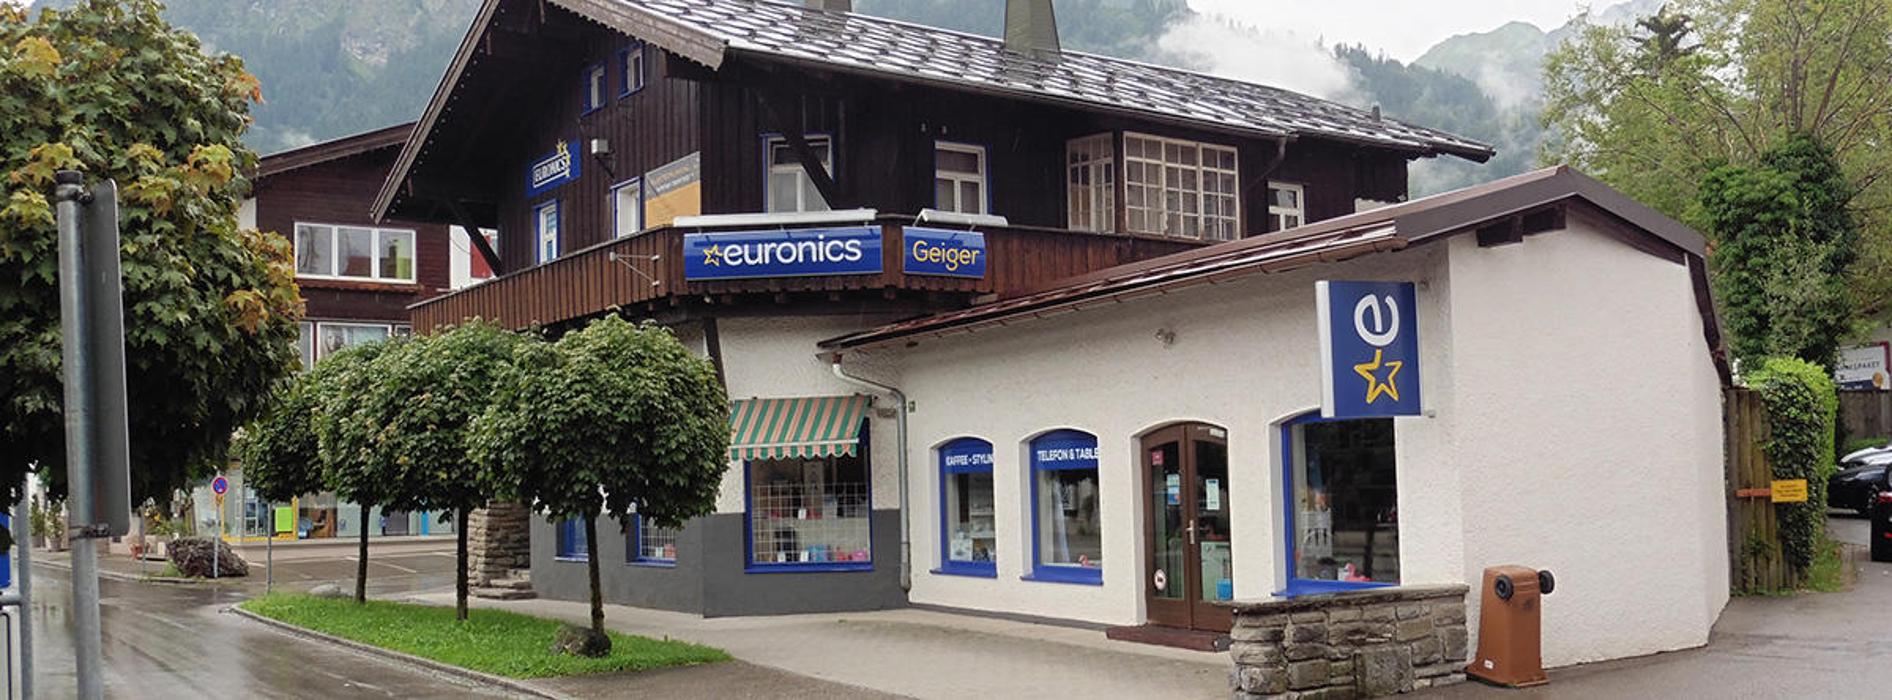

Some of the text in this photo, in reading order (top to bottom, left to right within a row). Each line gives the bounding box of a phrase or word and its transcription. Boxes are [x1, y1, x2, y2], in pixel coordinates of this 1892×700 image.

[533, 156, 567, 182] EURONICS
[723, 234, 862, 266] euronics
[912, 240, 980, 271] Geiger
[945, 454, 969, 466] KAFFEE
[1037, 449, 1068, 462] TELEFON
